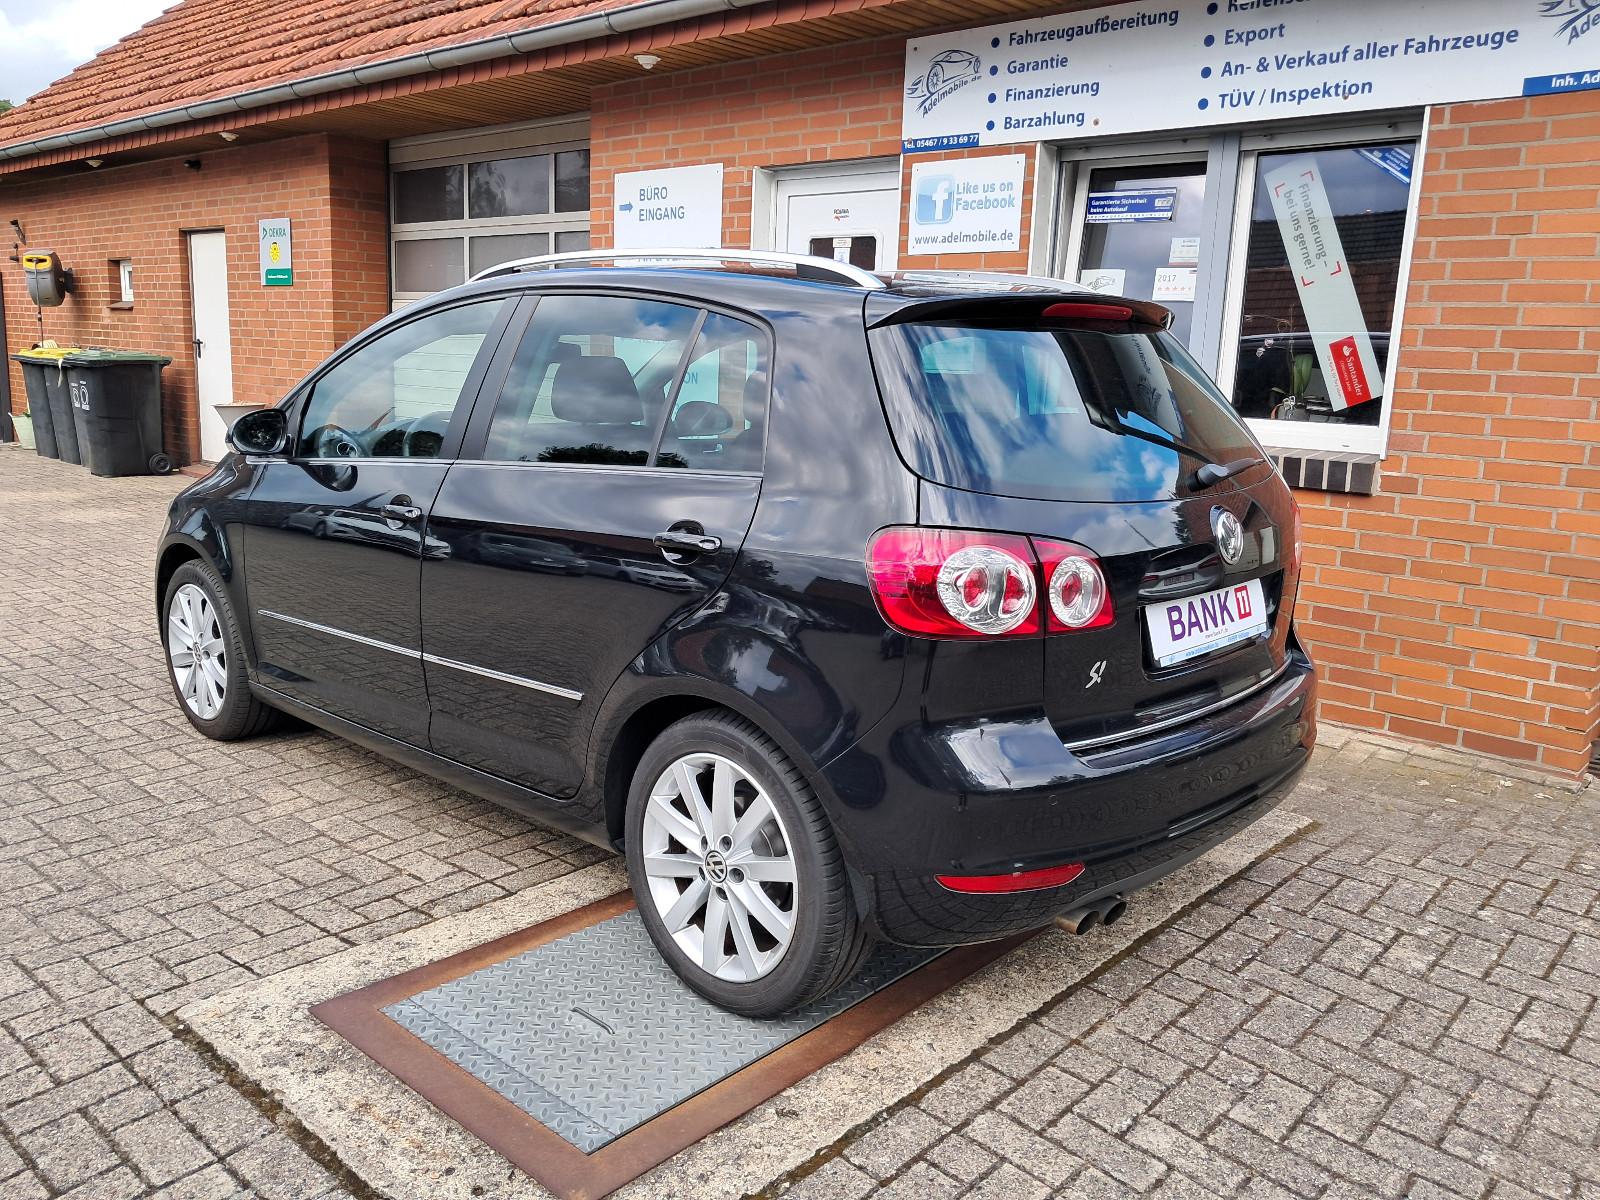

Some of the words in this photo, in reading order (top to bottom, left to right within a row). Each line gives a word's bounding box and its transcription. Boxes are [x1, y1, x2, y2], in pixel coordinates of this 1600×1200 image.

[1009, 10, 1179, 46] Fahrzeugaufbereitung
[1224, 23, 1286, 46] Export
[1568, 13, 1600, 46] Ade
[1220, 61, 1252, 77] An-
[1256, 56, 1270, 73] &
[1274, 45, 1350, 71] Verkauf
[1353, 41, 1399, 62] aller
[1403, 29, 1519, 55] Fahrzeuge
[1007, 54, 1069, 74] Garantie
[1551, 75, 1578, 88] Inh.
[1580, 72, 1600, 85] Ad
[1005, 81, 1100, 102] Finanzierung
[1218, 88, 1256, 109] TÜV
[1258, 88, 1267, 106] /
[1270, 80, 1373, 105] Inspektion
[1003, 111, 1085, 130] Barzahlung
[916, 138, 937, 148] 05467
[942, 137, 948, 146] 9
[948, 136, 958, 145] 33
[958, 135, 968, 144] 69
[969, 134, 979, 143] 77
[639, 185, 668, 202] BÜRO
[956, 181, 979, 195] Like
[982, 182, 996, 193] us
[999, 181, 1014, 192] on
[955, 194, 1015, 211] Facebook
[1283, 189, 1298, 210] bei
[638, 205, 685, 222] EINGANG
[1289, 211, 1302, 232] uns
[1298, 183, 1327, 260] Finanzierung
[914, 229, 1014, 245] www.adelmobile.de
[1293, 232, 1315, 270] gerne!
[1157, 274, 1177, 283] 2017
[1346, 356, 1362, 396] Santander
[1166, 590, 1235, 642] BANK
[1236, 590, 1250, 617] 11
